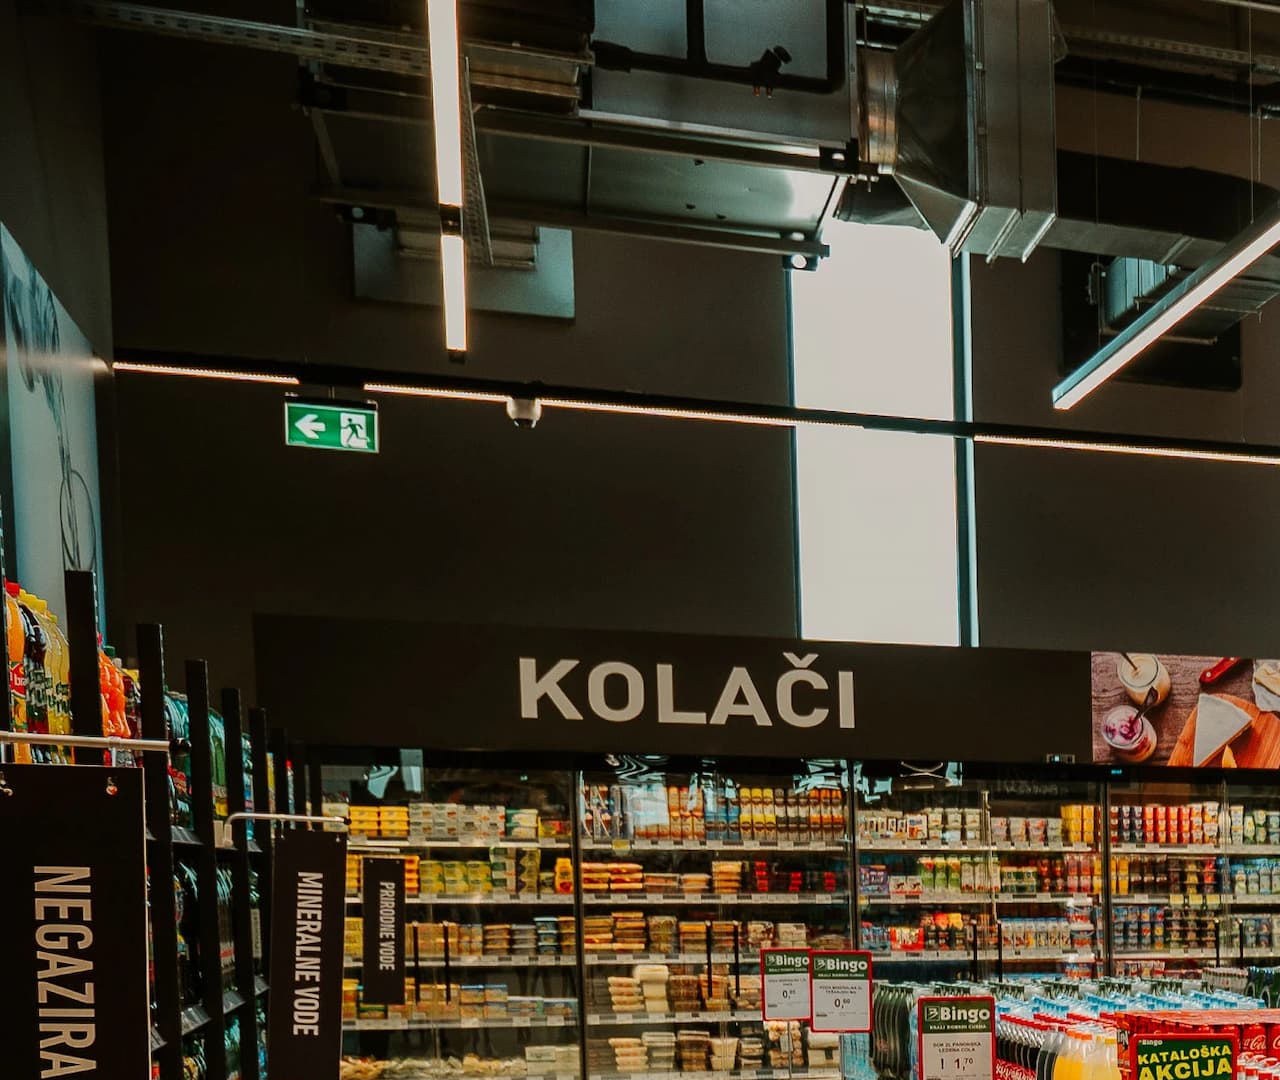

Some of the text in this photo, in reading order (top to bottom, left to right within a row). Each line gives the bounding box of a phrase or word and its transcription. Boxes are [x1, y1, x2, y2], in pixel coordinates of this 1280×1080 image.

[519, 652, 856, 728] KOLAČI
[379, 881, 396, 971] PRIRODNE VODE
[293, 871, 323, 1037] MINERALNE VODE
[776, 955, 810, 967] Bingo
[828, 959, 868, 972] Bingo
[940, 1006, 990, 1023] Bingo
[1138, 1045, 1232, 1065] KATALOŠKA
